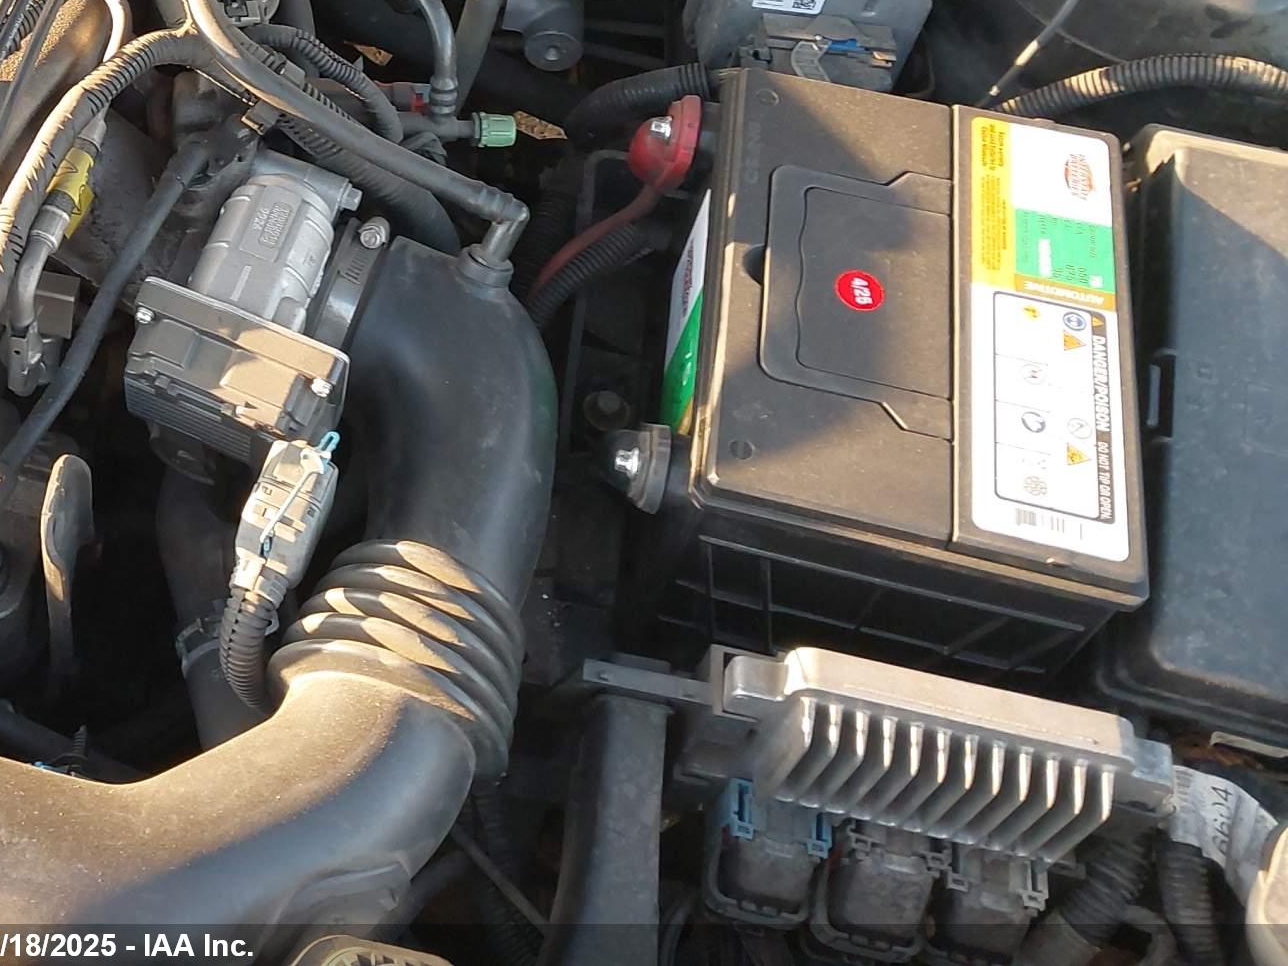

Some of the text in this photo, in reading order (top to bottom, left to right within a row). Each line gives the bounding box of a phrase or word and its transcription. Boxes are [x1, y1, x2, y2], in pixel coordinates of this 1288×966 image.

[1023, 280, 1105, 306] AUTOMOTIVE
[1092, 335, 1111, 433] DANGER/POISON
[1097, 441, 1109, 452] DO
[1098, 453, 1110, 470] NOT
[1099, 471, 1110, 484] TIP
